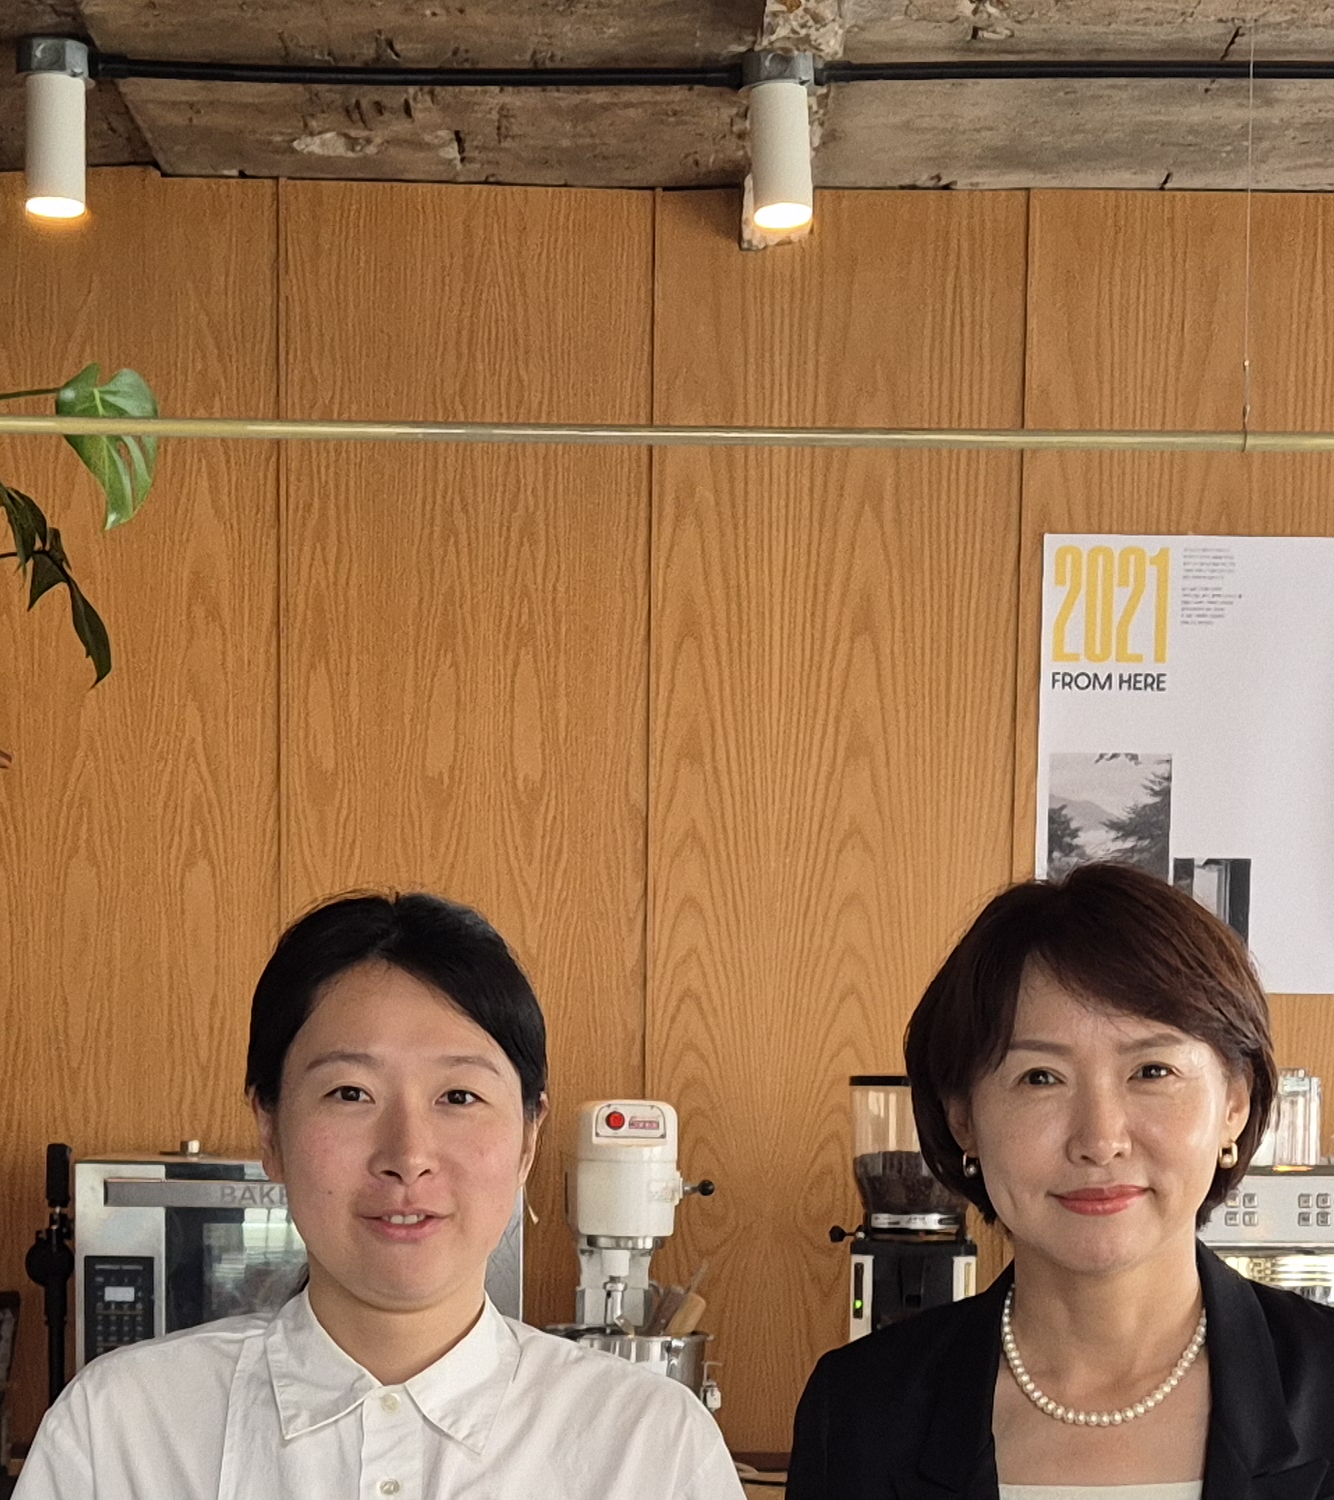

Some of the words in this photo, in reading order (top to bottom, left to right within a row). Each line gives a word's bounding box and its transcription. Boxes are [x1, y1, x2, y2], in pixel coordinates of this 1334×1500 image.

[1051, 545, 1170, 663] 2021
[1051, 671, 1112, 692] FROM
[1118, 672, 1167, 692] HERE
